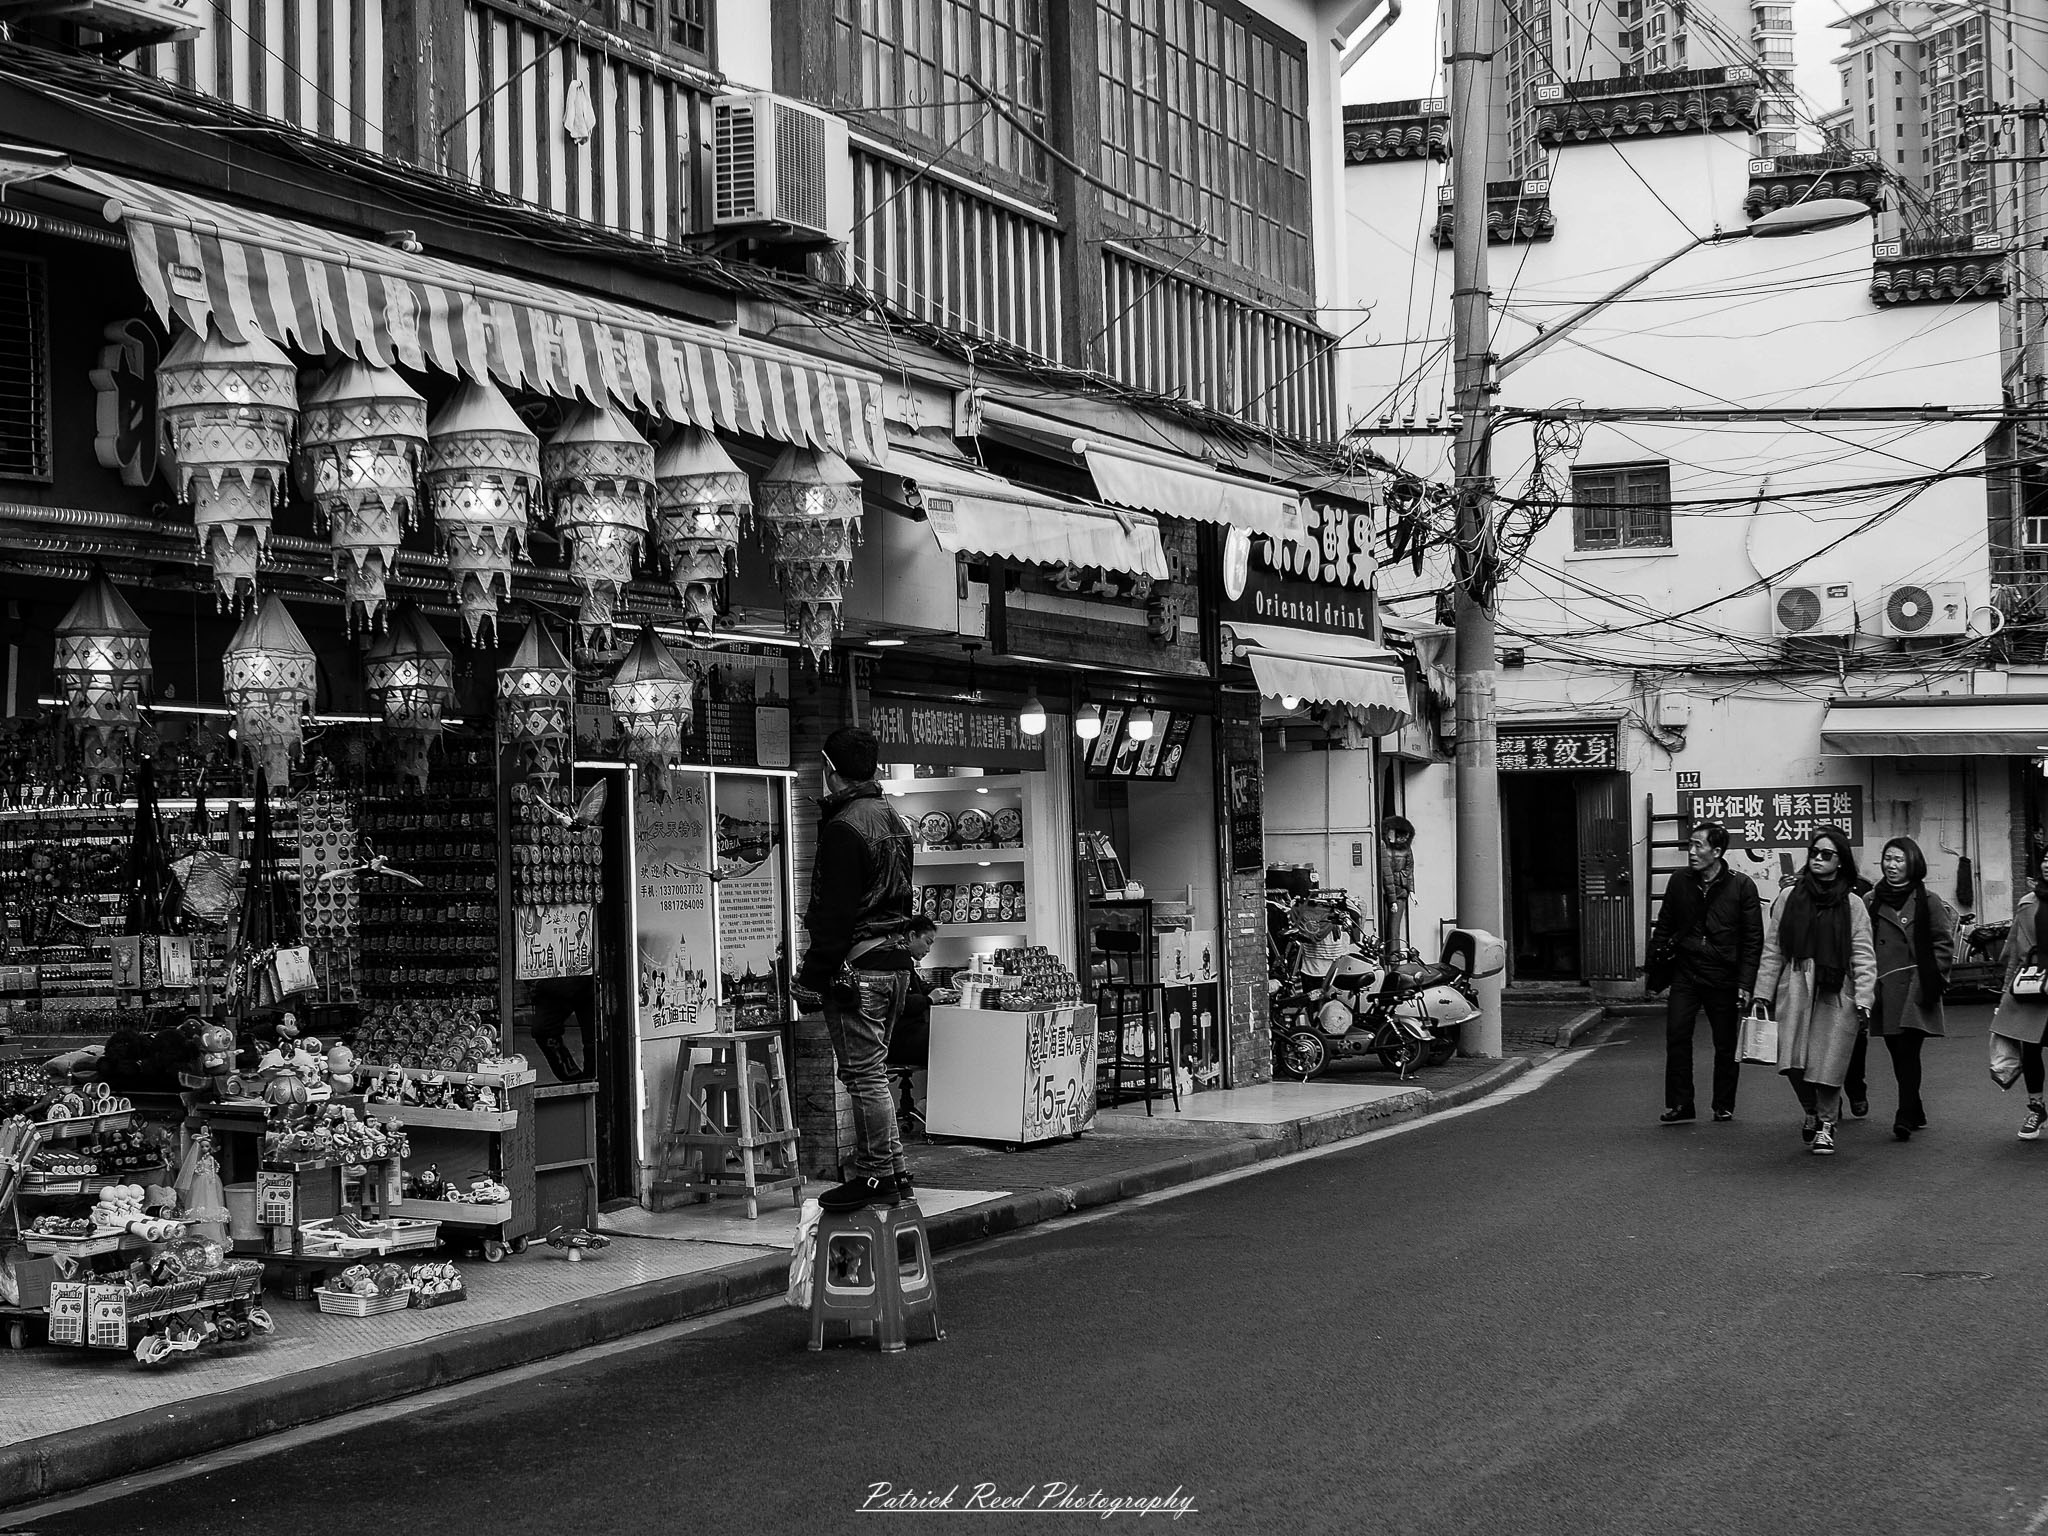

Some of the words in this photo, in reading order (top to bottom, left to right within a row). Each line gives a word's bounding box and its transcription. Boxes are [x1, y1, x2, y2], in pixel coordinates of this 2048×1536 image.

[1256, 590, 1320, 623] Oriental
[1324, 602, 1365, 629] drink
[1553, 737, 1608, 764] 纹身
[1679, 772, 1699, 783] 117
[1772, 792, 1853, 817] 情系百姓
[654, 821, 703, 838] 天天特价
[660, 900, 704, 911] 18817264009
[652, 1006, 697, 1029] 奇幻迪士尼
